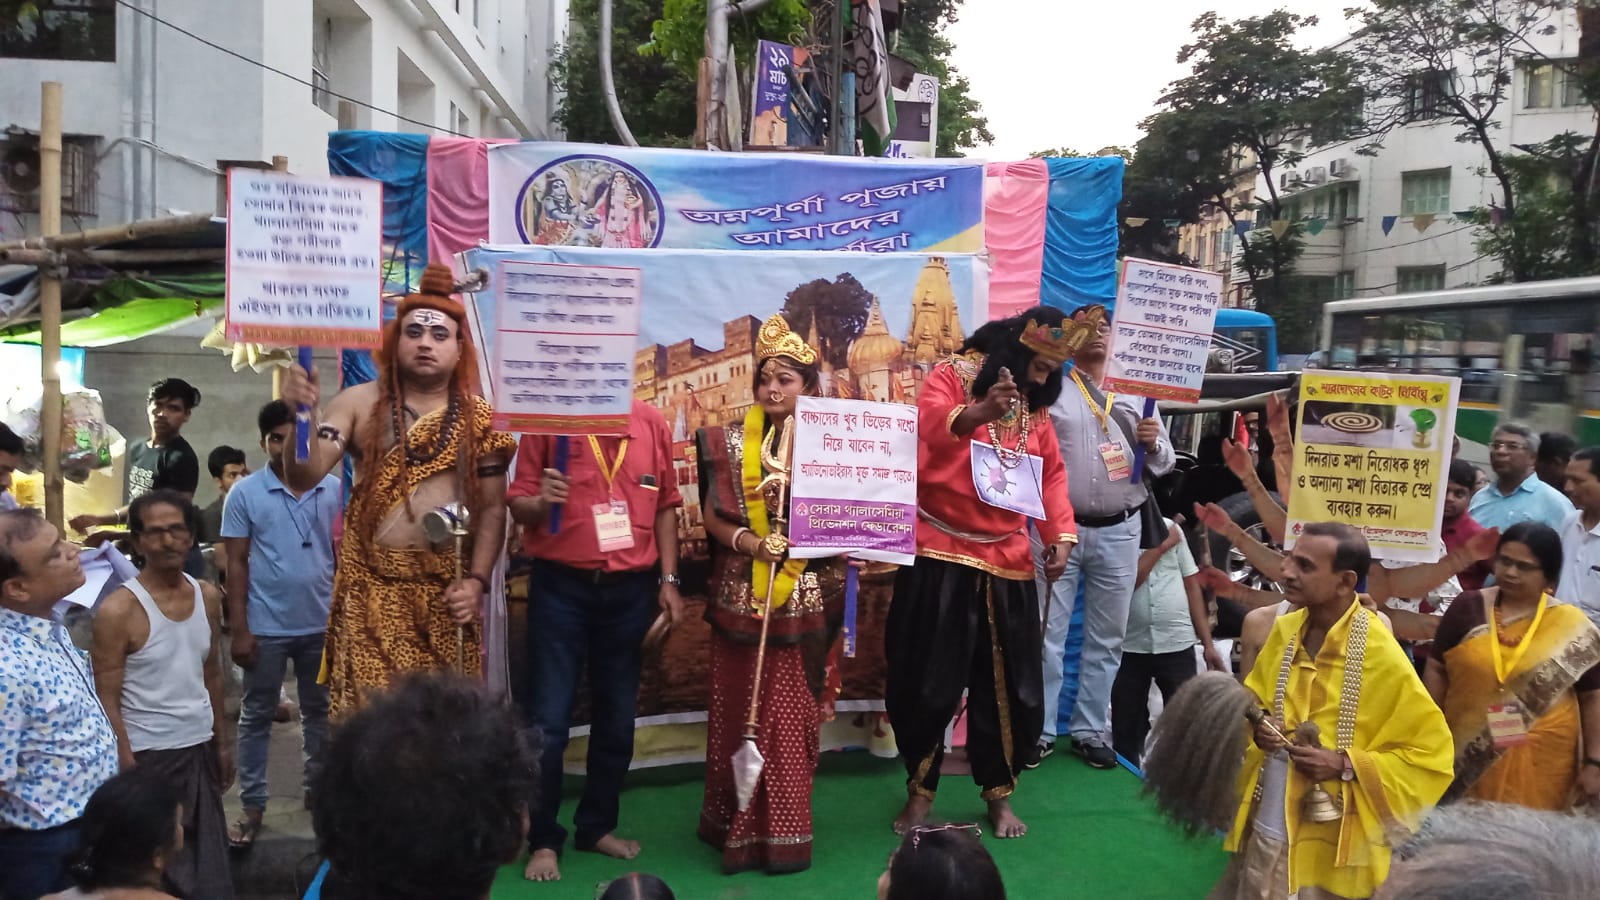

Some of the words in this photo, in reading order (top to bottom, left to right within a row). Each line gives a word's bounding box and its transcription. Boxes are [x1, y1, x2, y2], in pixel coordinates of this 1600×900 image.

[682, 196, 823, 225] অন্নপূর্ণা
[841, 177, 947, 207] পূজায়
[733, 210, 900, 245] আমাদের
[801, 410, 839, 426] বাচ্চাদের
[844, 414, 857, 432] খুব
[863, 411, 892, 432] ভিড়ের
[896, 418, 916, 433] মধ্যে
[823, 433, 843, 451] নিয়ে
[848, 439, 875, 453] যাবেন
[872, 467, 891, 481] সমাজ
[1305, 446, 1341, 469] দিনরাত
[1344, 453, 1363, 471] মশা
[1367, 449, 1409, 473] নিরোধক
[1413, 456, 1429, 479] ধূপ
[1298, 475, 1306, 489] ও
[1310, 475, 1343, 494] অন্যান্য
[1347, 478, 1366, 496] মশা
[1370, 475, 1410, 497] বিতারক
[1412, 482, 1432, 499] স্প্রে
[810, 504, 841, 515] সেরাম
[844, 504, 905, 520] থ্যালাসেমিয়া
[1326, 499, 1362, 519] ব্যবহার
